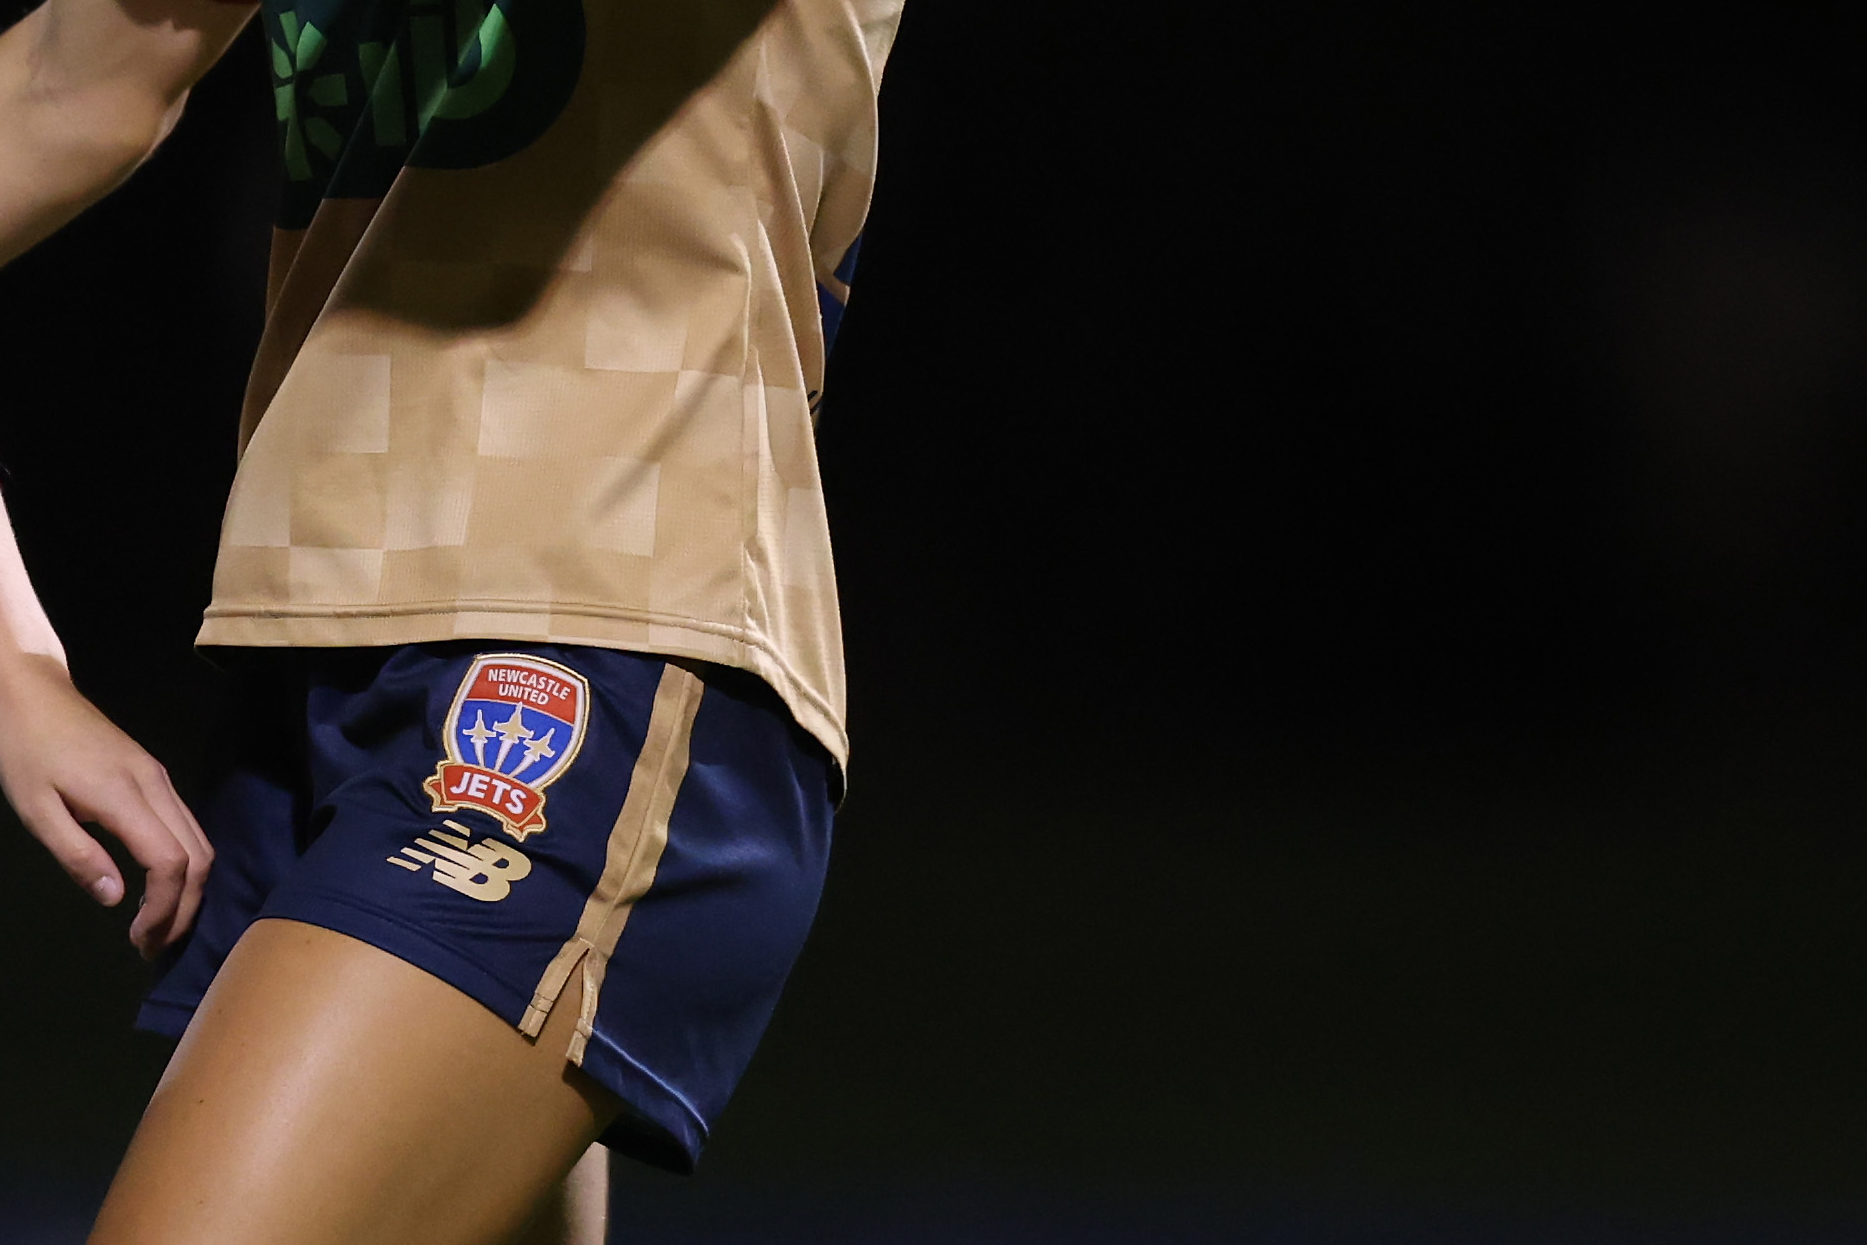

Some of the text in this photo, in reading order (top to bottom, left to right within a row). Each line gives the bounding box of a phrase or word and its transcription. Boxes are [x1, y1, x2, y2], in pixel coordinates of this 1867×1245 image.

[488, 668, 571, 701] NEWCASTLE
[498, 683, 550, 705] UNITED
[449, 771, 528, 815] JETS
